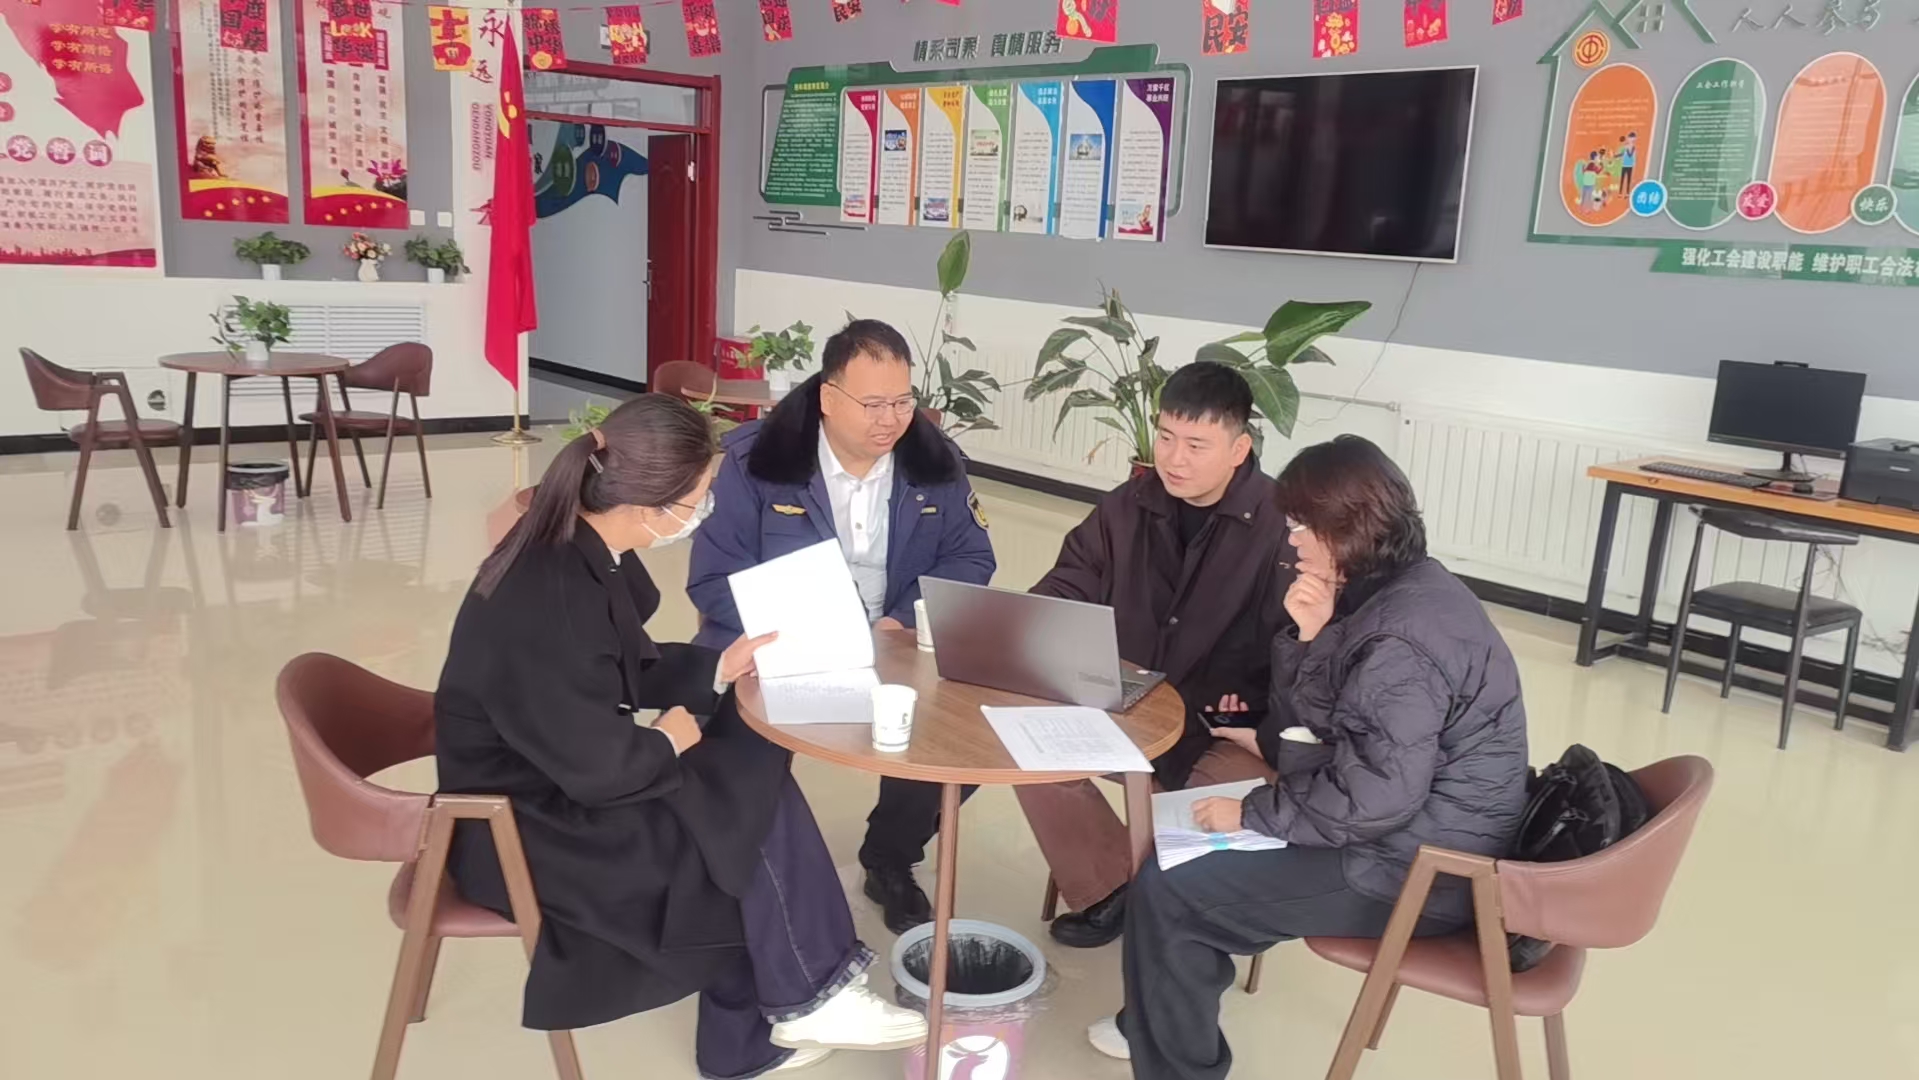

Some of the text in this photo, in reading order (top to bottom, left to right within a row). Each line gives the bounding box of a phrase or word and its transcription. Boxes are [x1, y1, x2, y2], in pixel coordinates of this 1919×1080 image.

[1681, 247, 1805, 272] 强化工会建设职能
